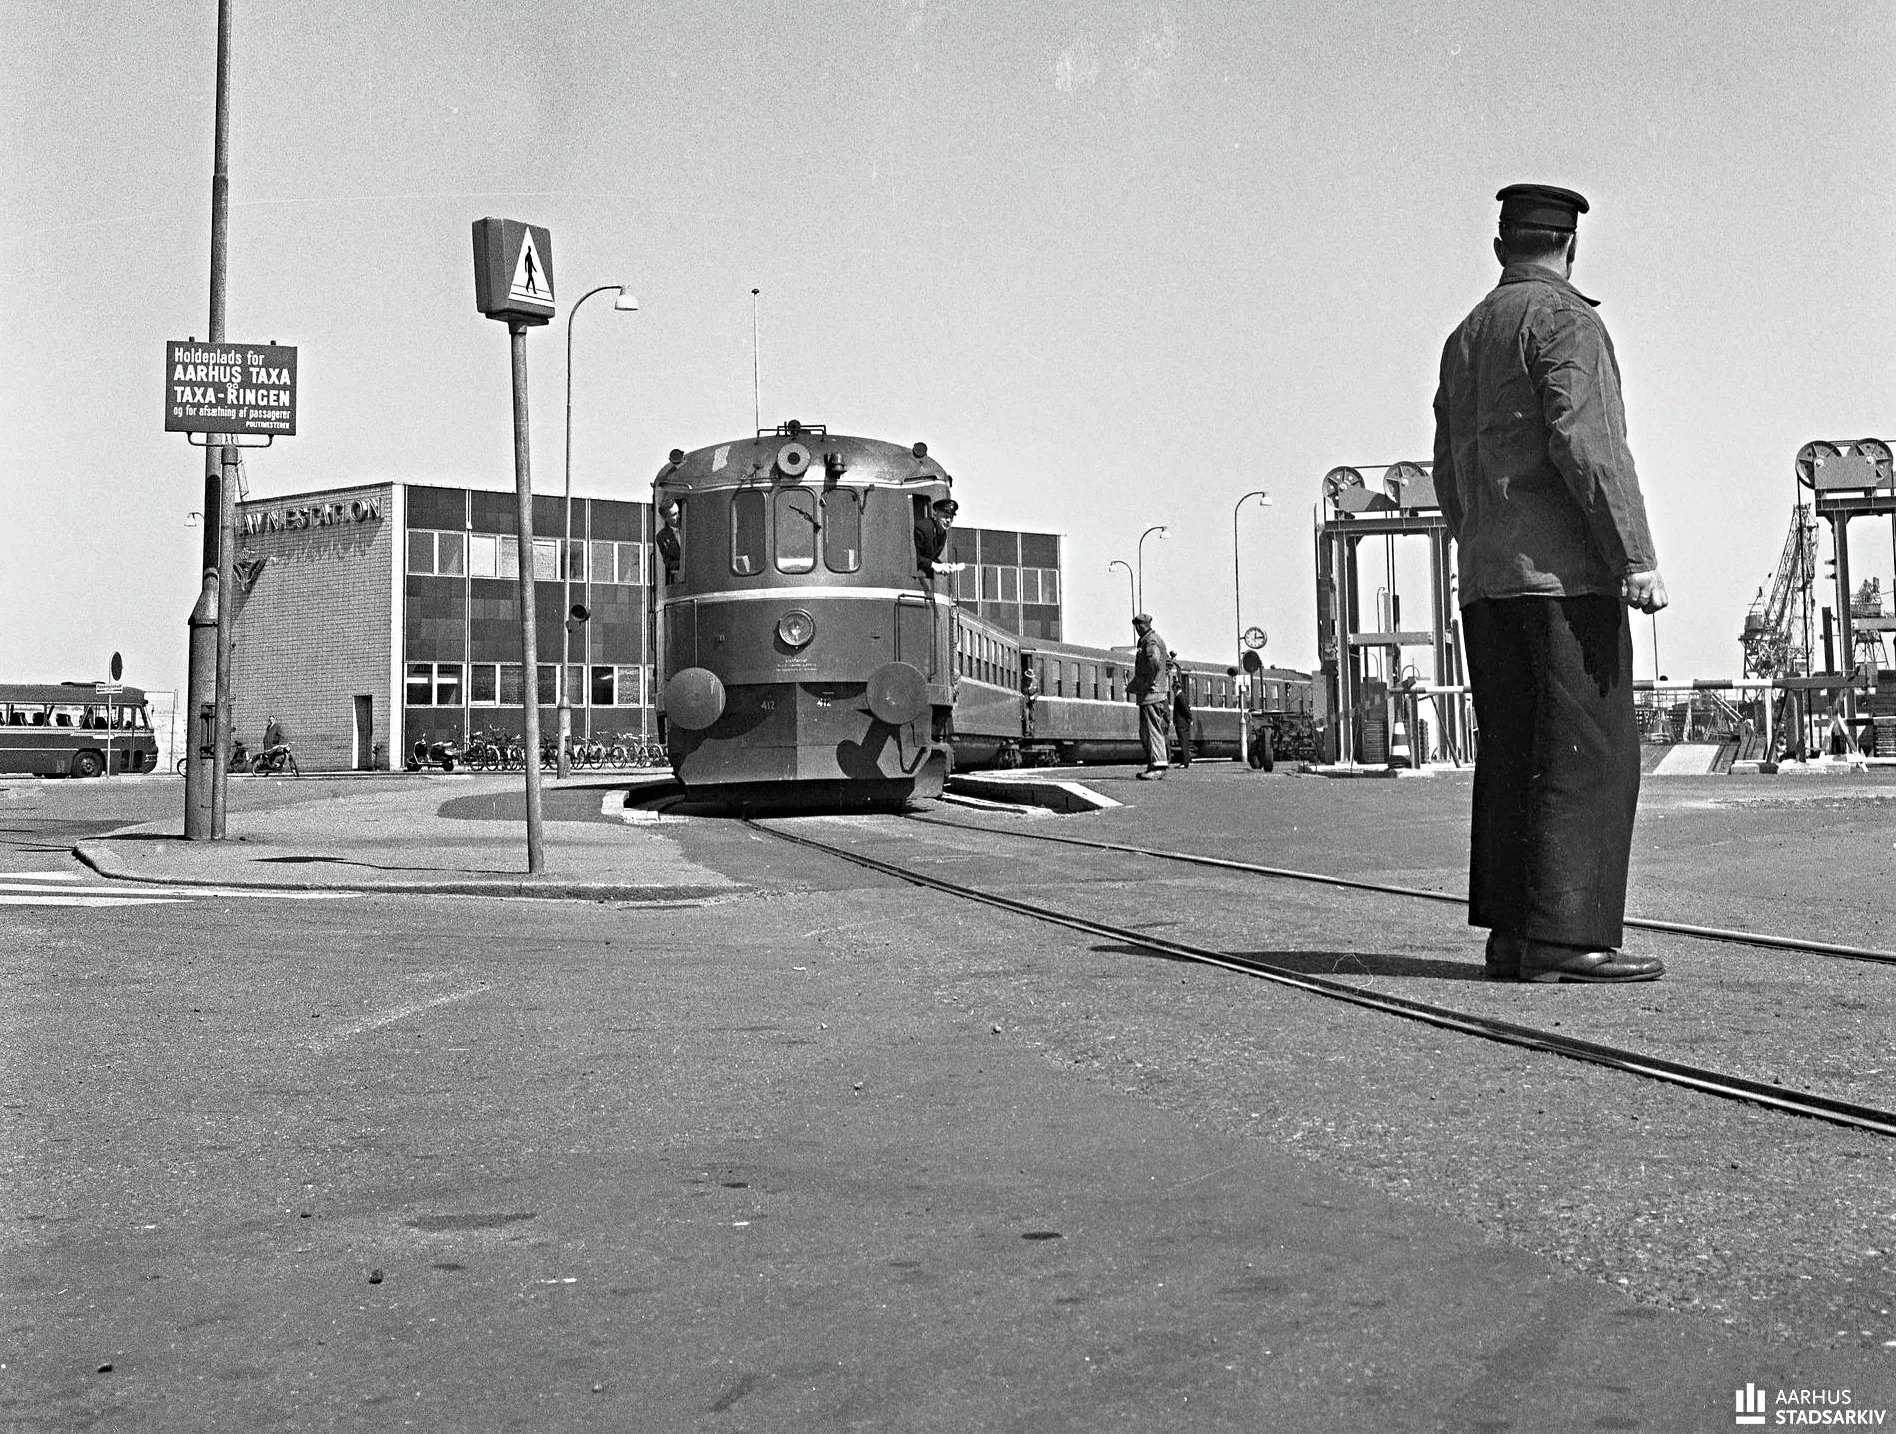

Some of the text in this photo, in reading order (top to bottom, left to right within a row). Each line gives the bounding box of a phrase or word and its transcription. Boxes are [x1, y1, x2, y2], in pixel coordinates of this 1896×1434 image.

[174, 347, 265, 366] Holdeplads for
[174, 364, 291, 385] AARHUS TAXA
[173, 406, 183, 418] og
[186, 404, 197, 416] for
[239, 406, 248, 418] af
[249, 408, 291, 421] passagerer
[761, 700, 775, 711] 412
[816, 697, 832, 707] 412
